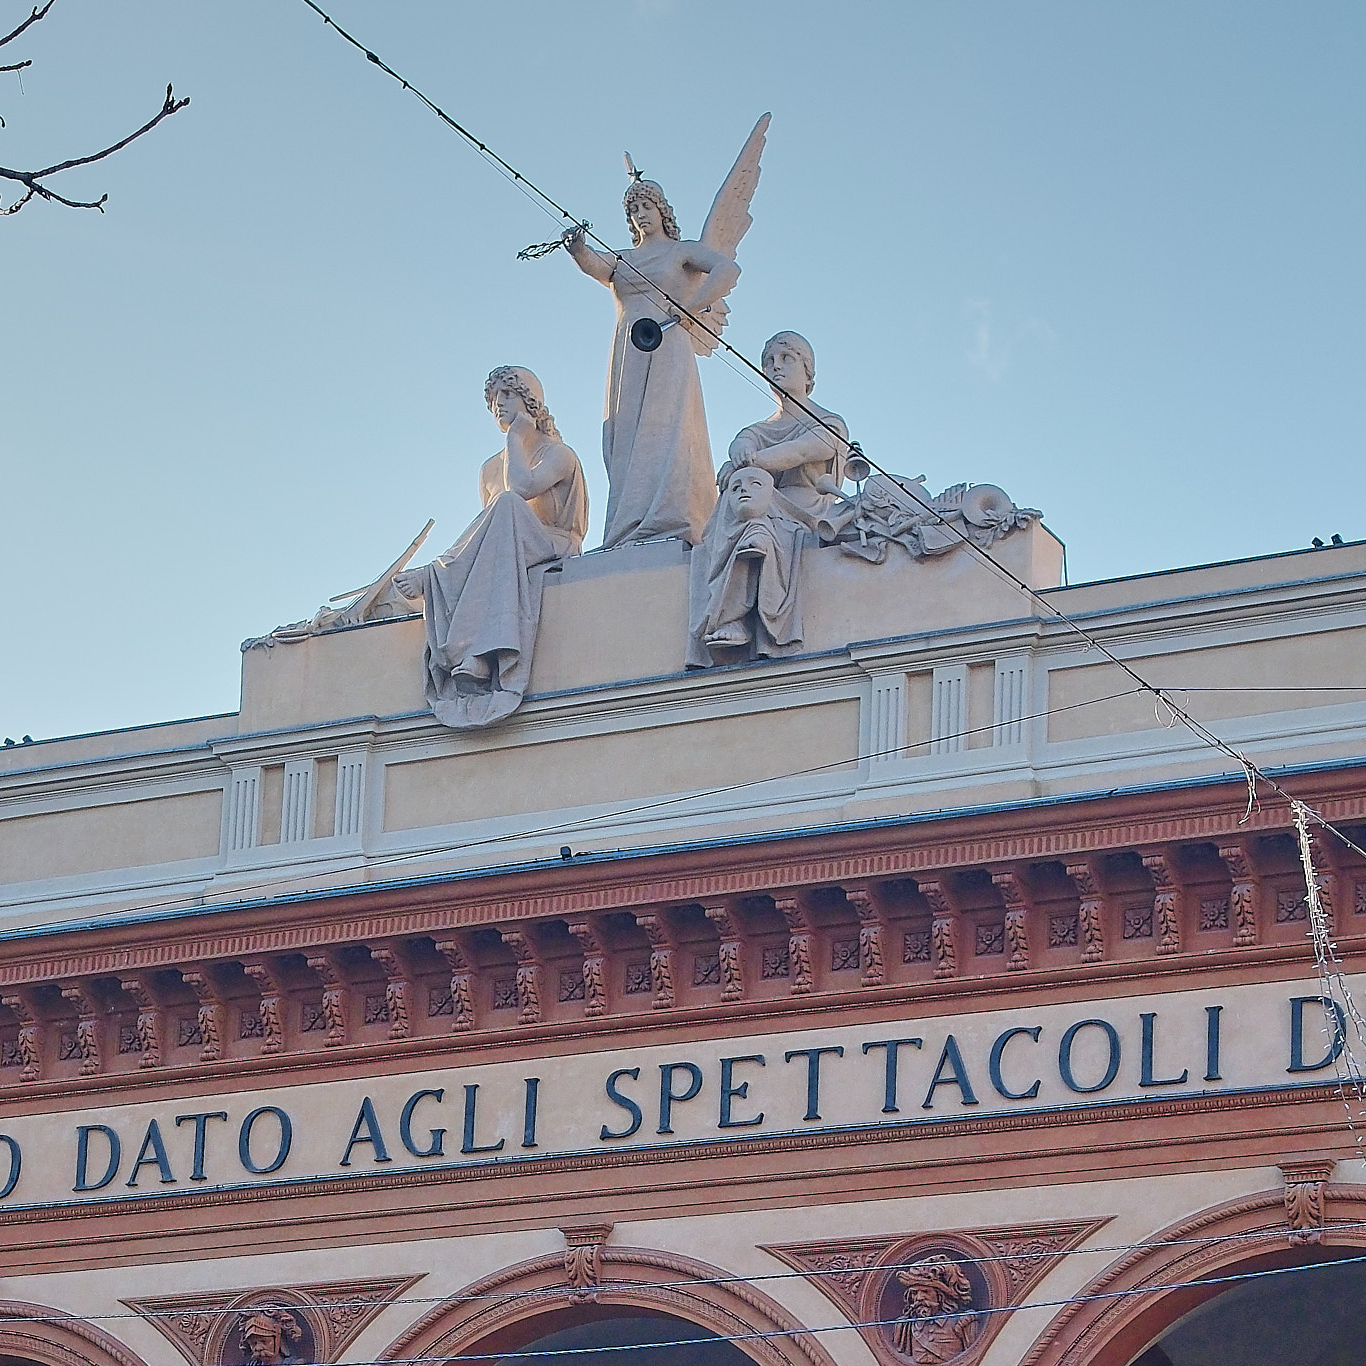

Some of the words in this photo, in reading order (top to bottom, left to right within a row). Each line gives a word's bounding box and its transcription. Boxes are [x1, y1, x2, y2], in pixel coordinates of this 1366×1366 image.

[71, 1105, 294, 1193] DATO
[339, 1076, 540, 1167] AGLI
[598, 1005, 1224, 1142] SPETTACOLI
